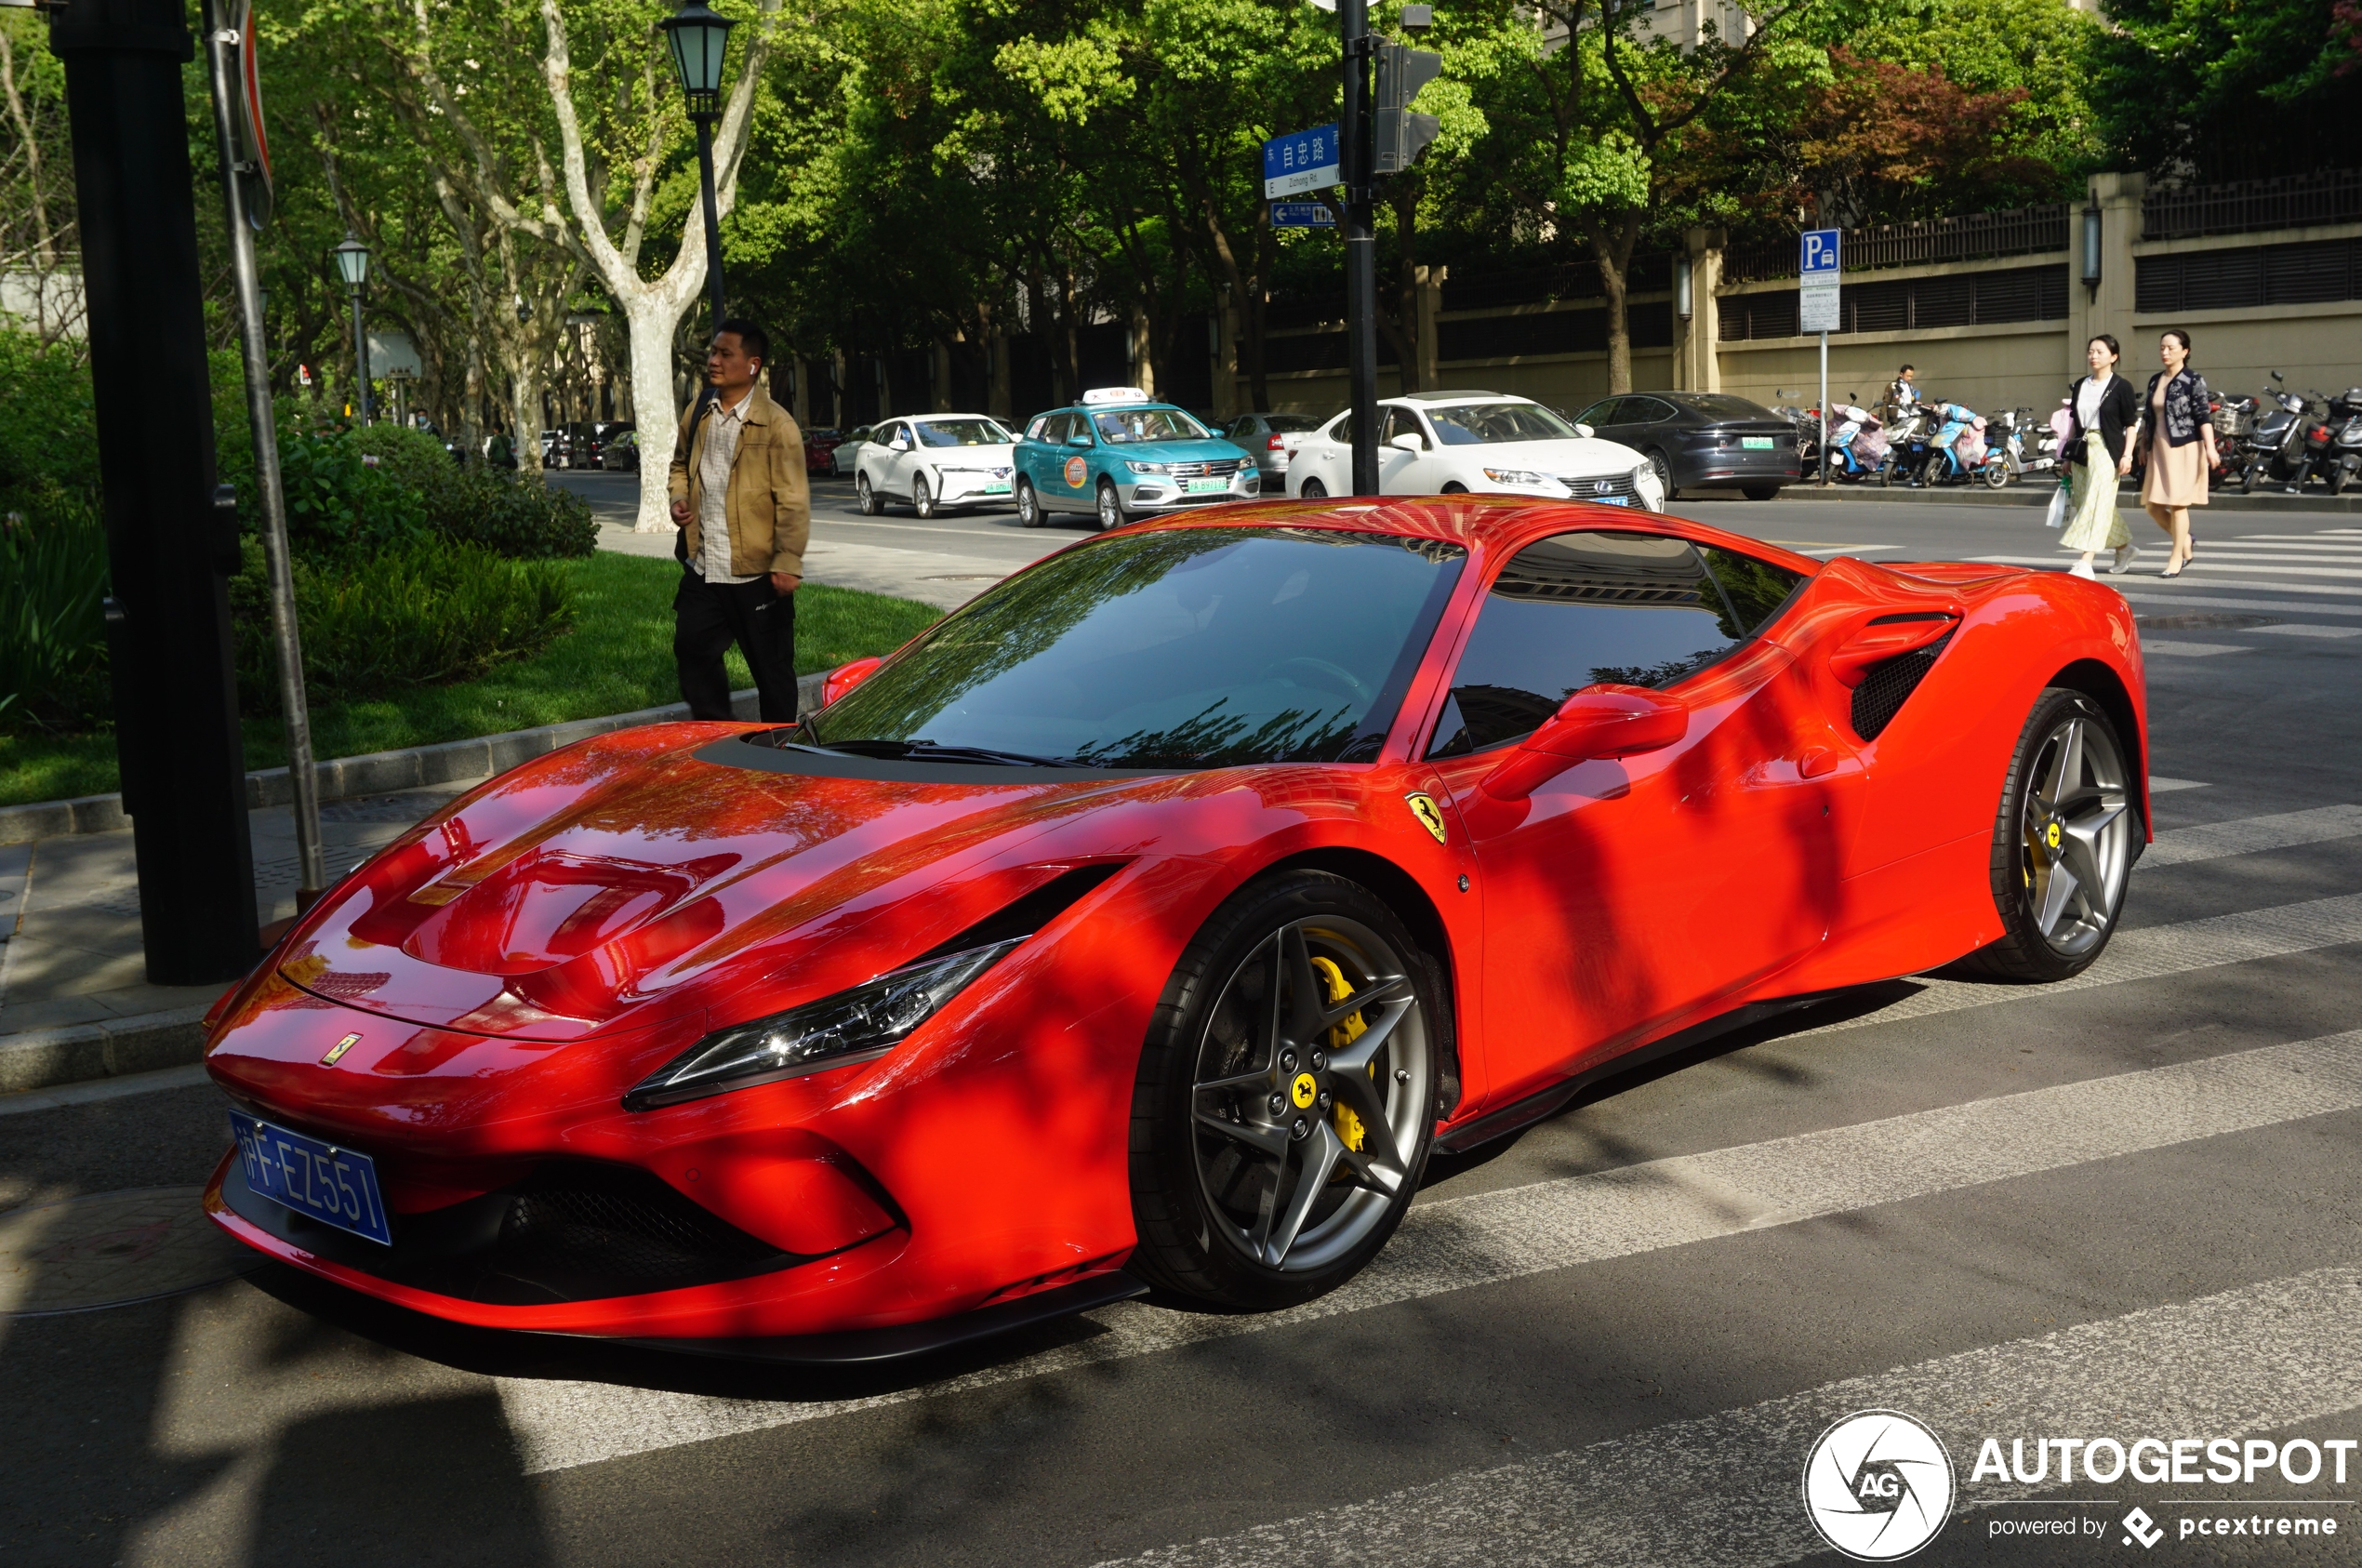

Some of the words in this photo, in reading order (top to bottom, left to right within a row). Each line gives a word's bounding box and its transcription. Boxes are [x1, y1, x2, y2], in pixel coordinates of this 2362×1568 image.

[1284, 137, 1323, 168] 自忠路
[1270, 181, 1274, 193] E
[1289, 176, 1308, 188] Zizhong
[1806, 235, 1822, 269] P
